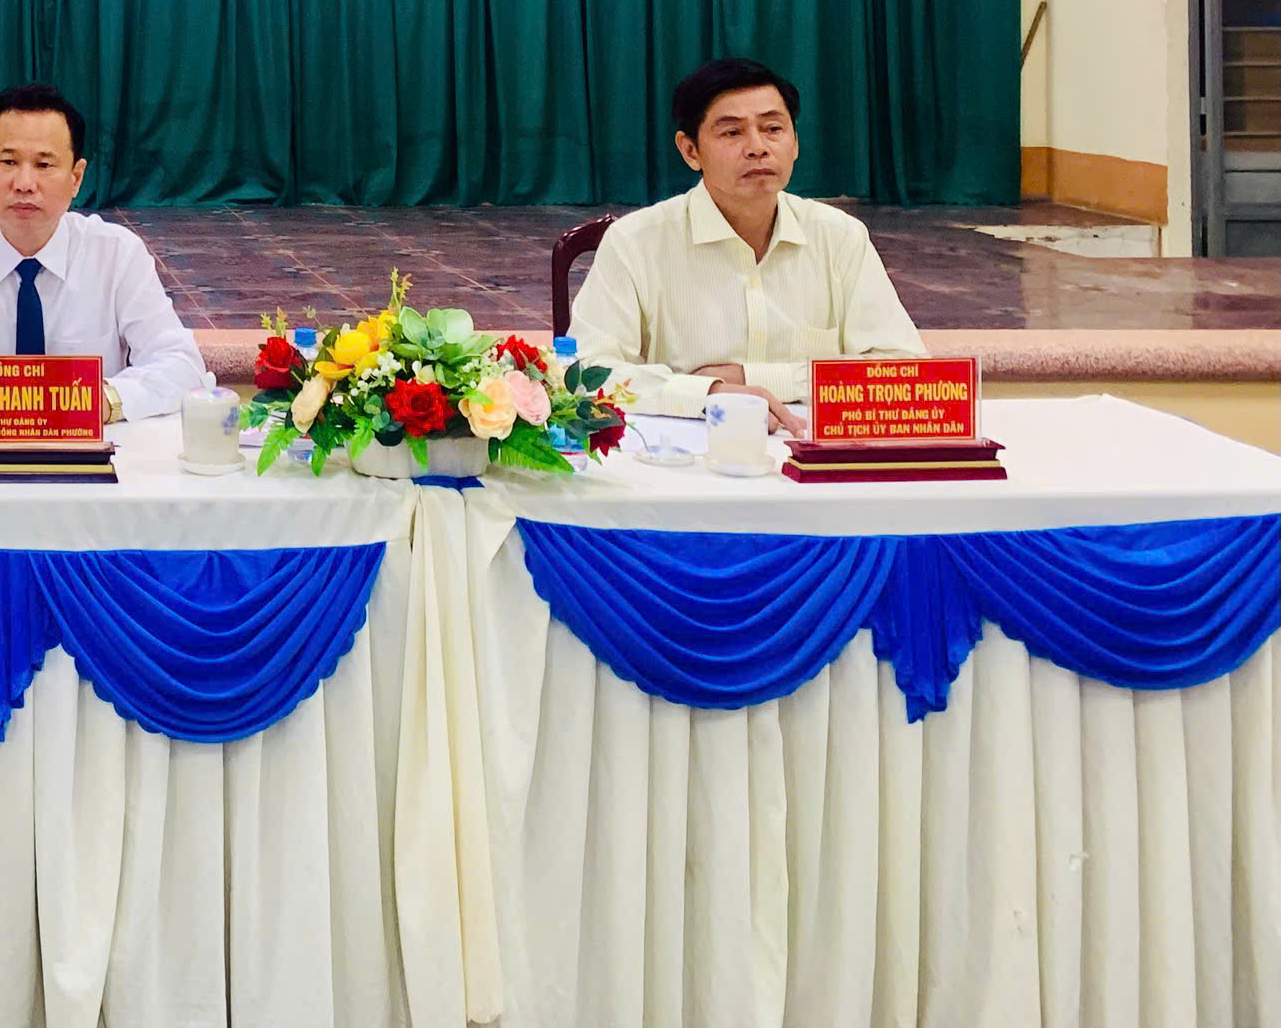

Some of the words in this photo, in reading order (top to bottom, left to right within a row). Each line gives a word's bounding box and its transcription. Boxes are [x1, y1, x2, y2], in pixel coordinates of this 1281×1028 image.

[23, 362, 45, 377] CHÍ
[900, 363, 918, 377] CHÍ
[48, 377, 92, 411] TUẤN
[819, 380, 863, 403] HOÀNG
[866, 382, 911, 405] TRỌNG
